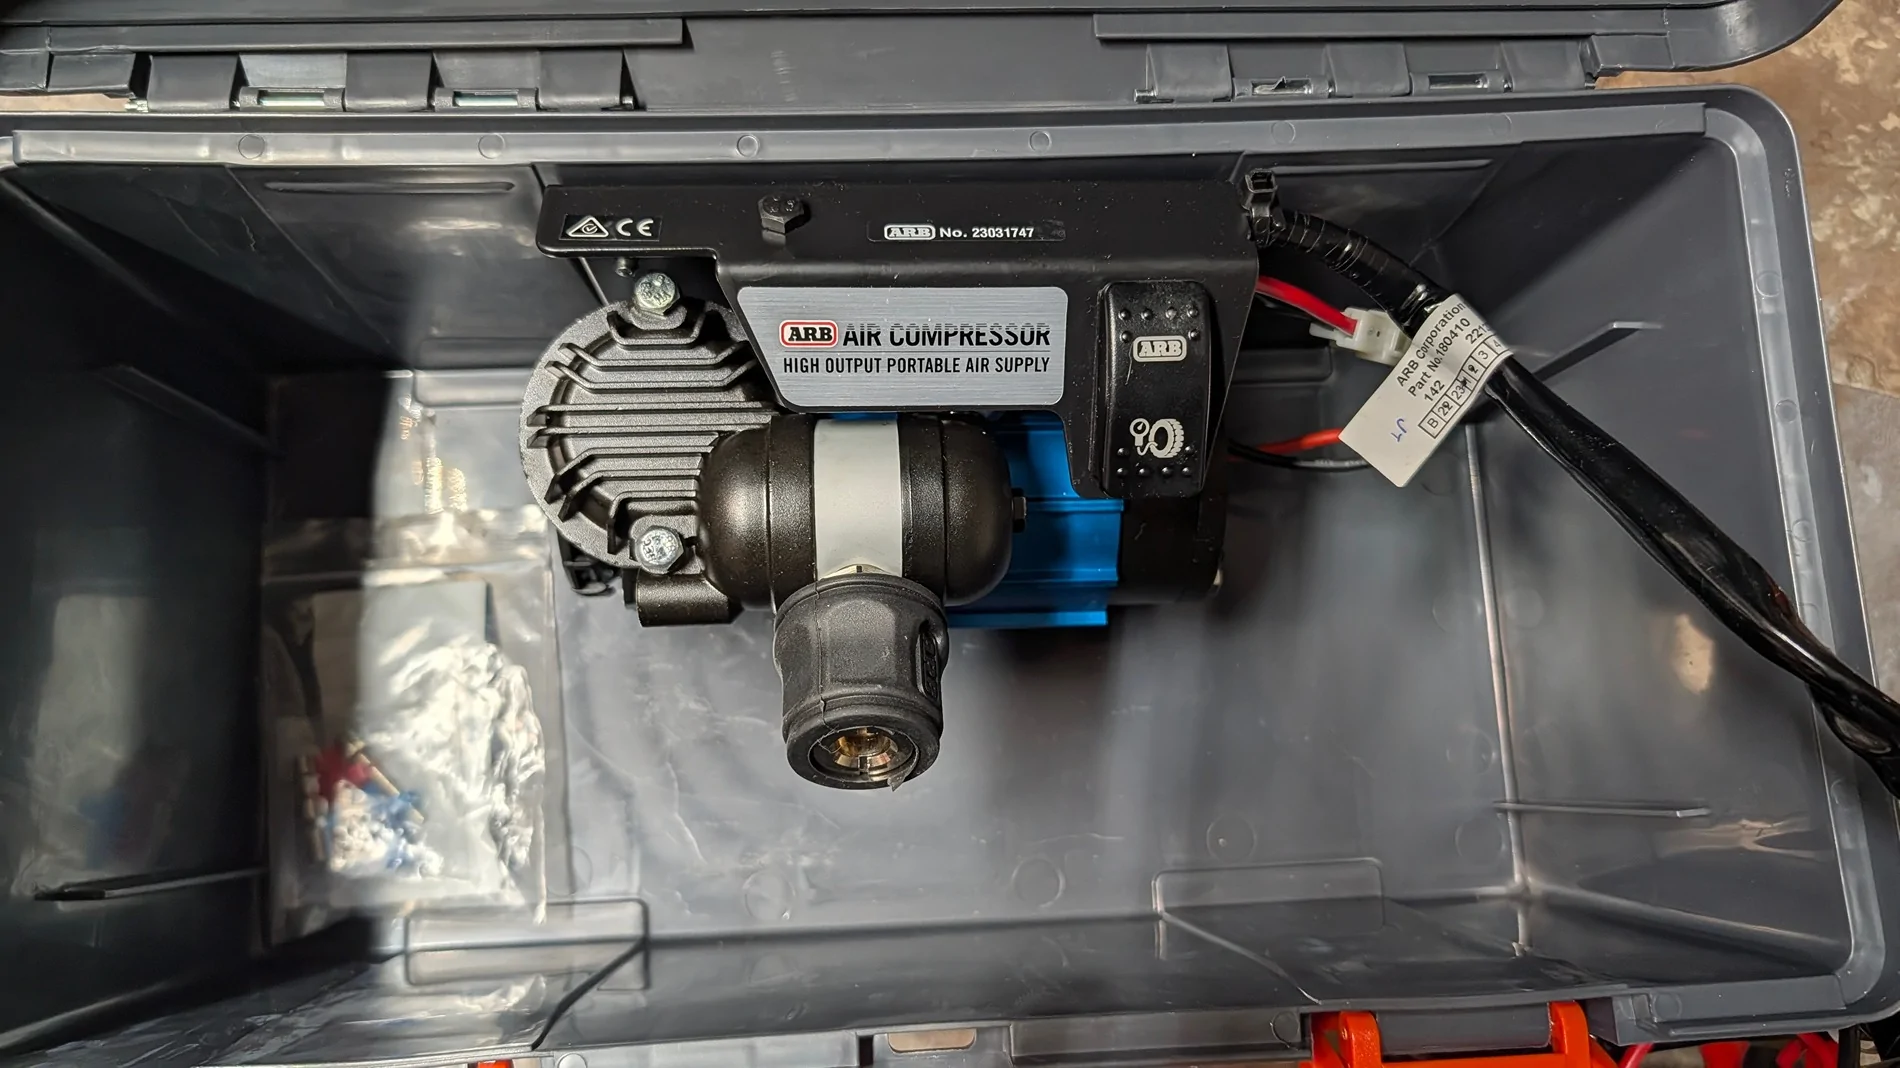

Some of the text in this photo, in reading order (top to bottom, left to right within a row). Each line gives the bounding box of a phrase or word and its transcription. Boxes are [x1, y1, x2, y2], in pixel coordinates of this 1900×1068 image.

[888, 227, 1035, 238] ARB No. 23031747
[787, 322, 1051, 346] ARB AIR COMPRESSOR
[1396, 302, 1466, 387] ARB Corporation
[1138, 340, 1182, 357] ARB
[783, 356, 1050, 373] HIGH OUTPUT PORTABLE AIR SUPPLY
[1407, 371, 1431, 397] Part
[1424, 380, 1445, 402] 142
[1427, 418, 1439, 429] B
[1478, 350, 1489, 360] 3
